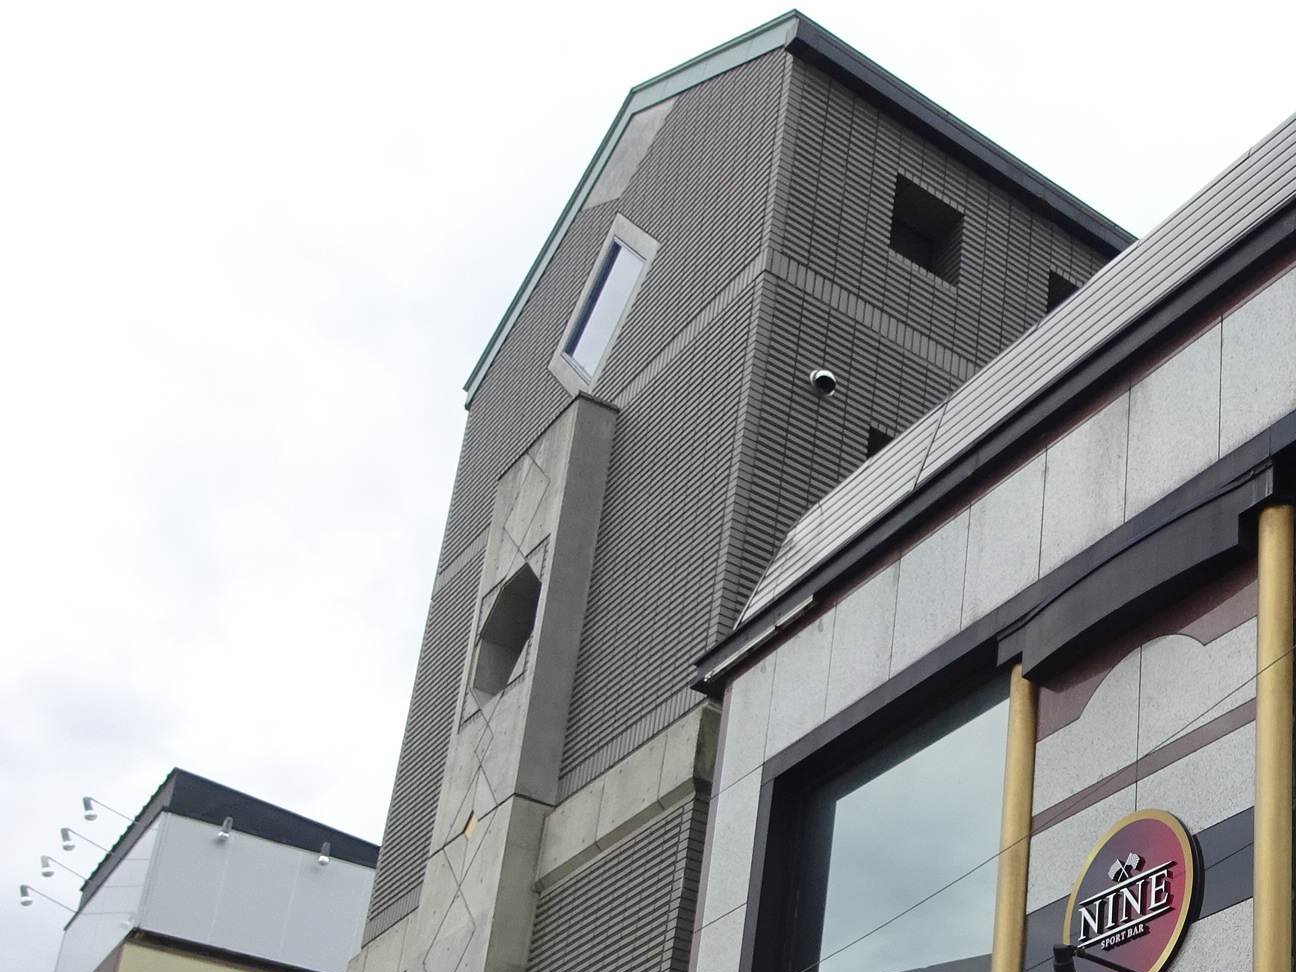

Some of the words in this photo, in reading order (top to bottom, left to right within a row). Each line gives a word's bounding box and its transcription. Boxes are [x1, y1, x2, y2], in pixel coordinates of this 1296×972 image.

[1078, 869, 1169, 941] NINE
[1100, 931, 1127, 949] SPORT
[1127, 923, 1144, 937] BAR
